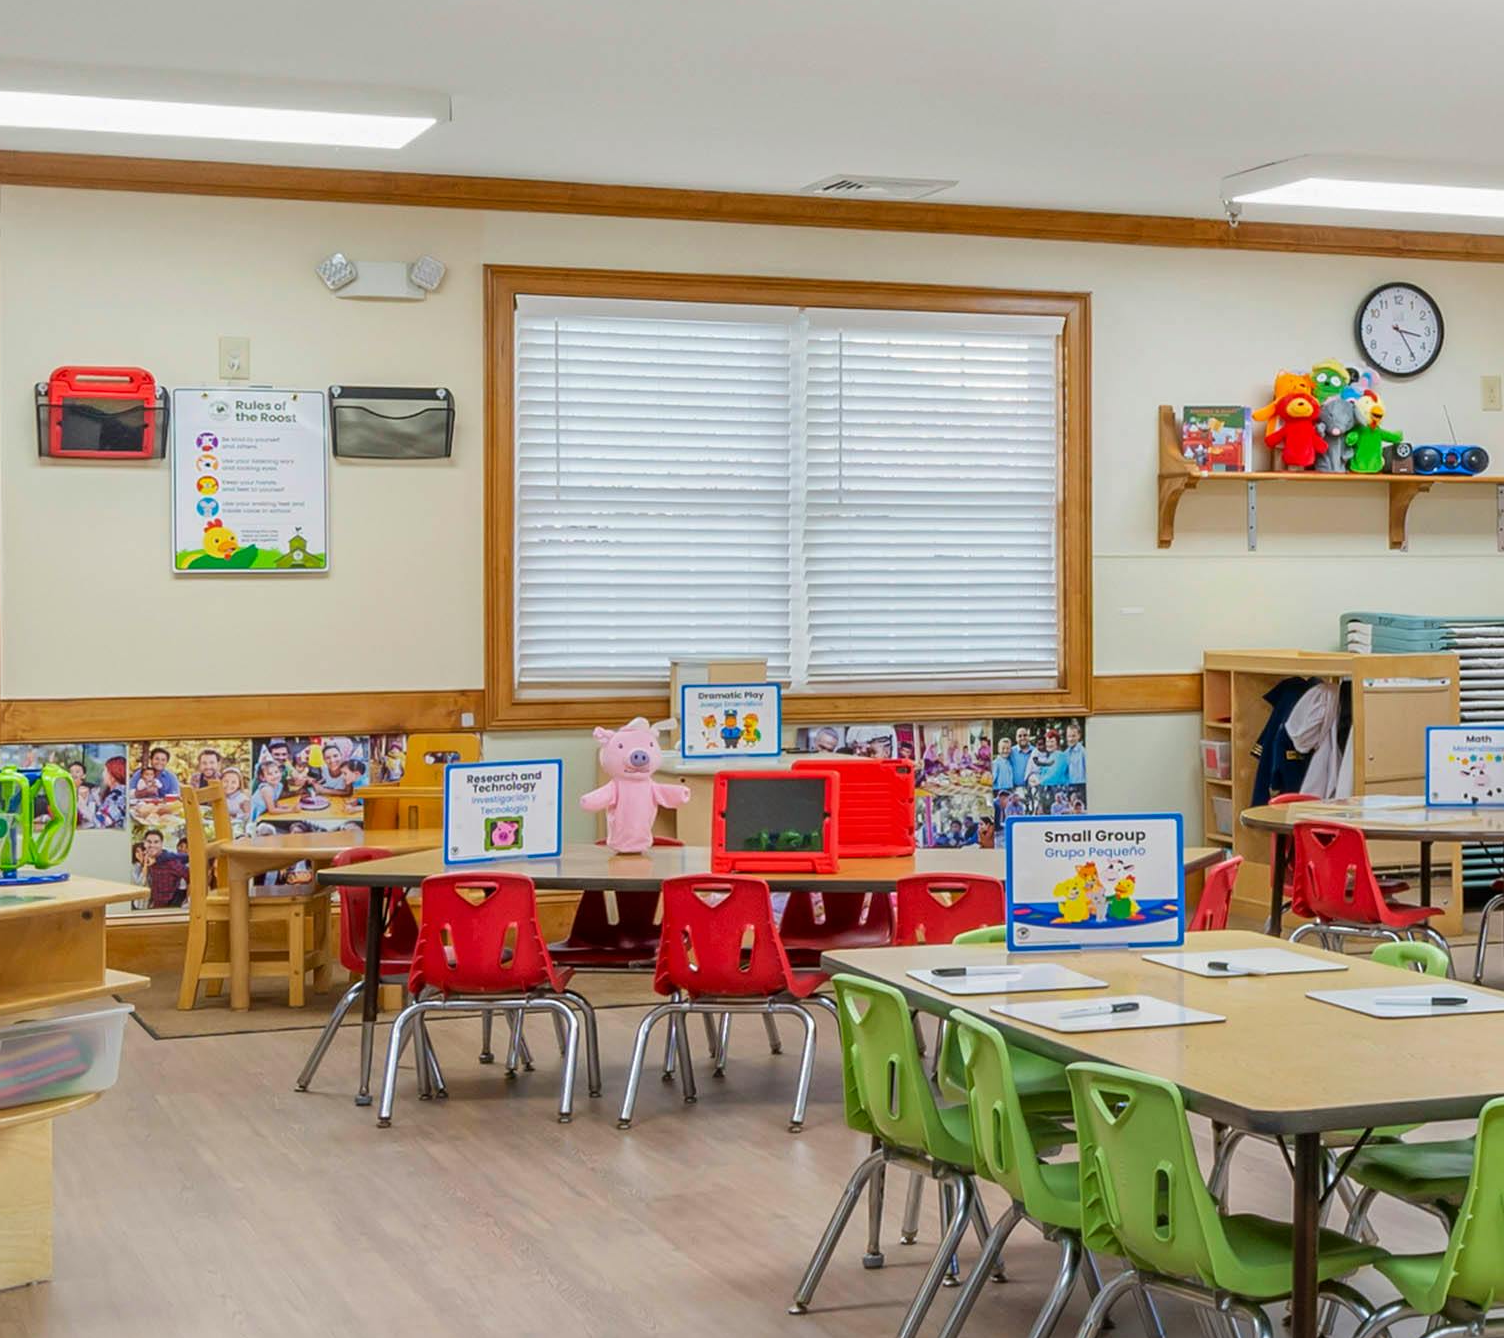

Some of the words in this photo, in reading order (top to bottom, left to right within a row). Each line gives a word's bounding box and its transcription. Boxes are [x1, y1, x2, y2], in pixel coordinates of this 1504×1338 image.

[1379, 300, 1388, 309] 11
[1394, 295, 1403, 305] 12
[1409, 301, 1414, 310] 1
[1370, 309, 1380, 318] 10
[1419, 310, 1426, 320] 2
[1366, 324, 1372, 334] 9
[1424, 326, 1431, 337] 3
[1370, 340, 1377, 349] 8
[1420, 342, 1426, 351] 4
[1382, 351, 1388, 361] 7
[1395, 356, 1401, 366] 6
[235, 400, 271, 410] Rules
[274, 401, 286, 410] of
[236, 413, 257, 421] the
[260, 413, 296, 423] Roost
[698, 692, 742, 700] Dramatic
[744, 692, 764, 700] Play
[1466, 735, 1492, 743] Math
[466, 772, 518, 784] Research
[520, 771, 542, 780] and
[473, 782, 536, 793] Technology
[1044, 830, 1091, 843] Small
[1095, 830, 1146, 844] Group
[1045, 847, 1085, 860] Grupo
[1088, 845, 1146, 858] Pequeño
